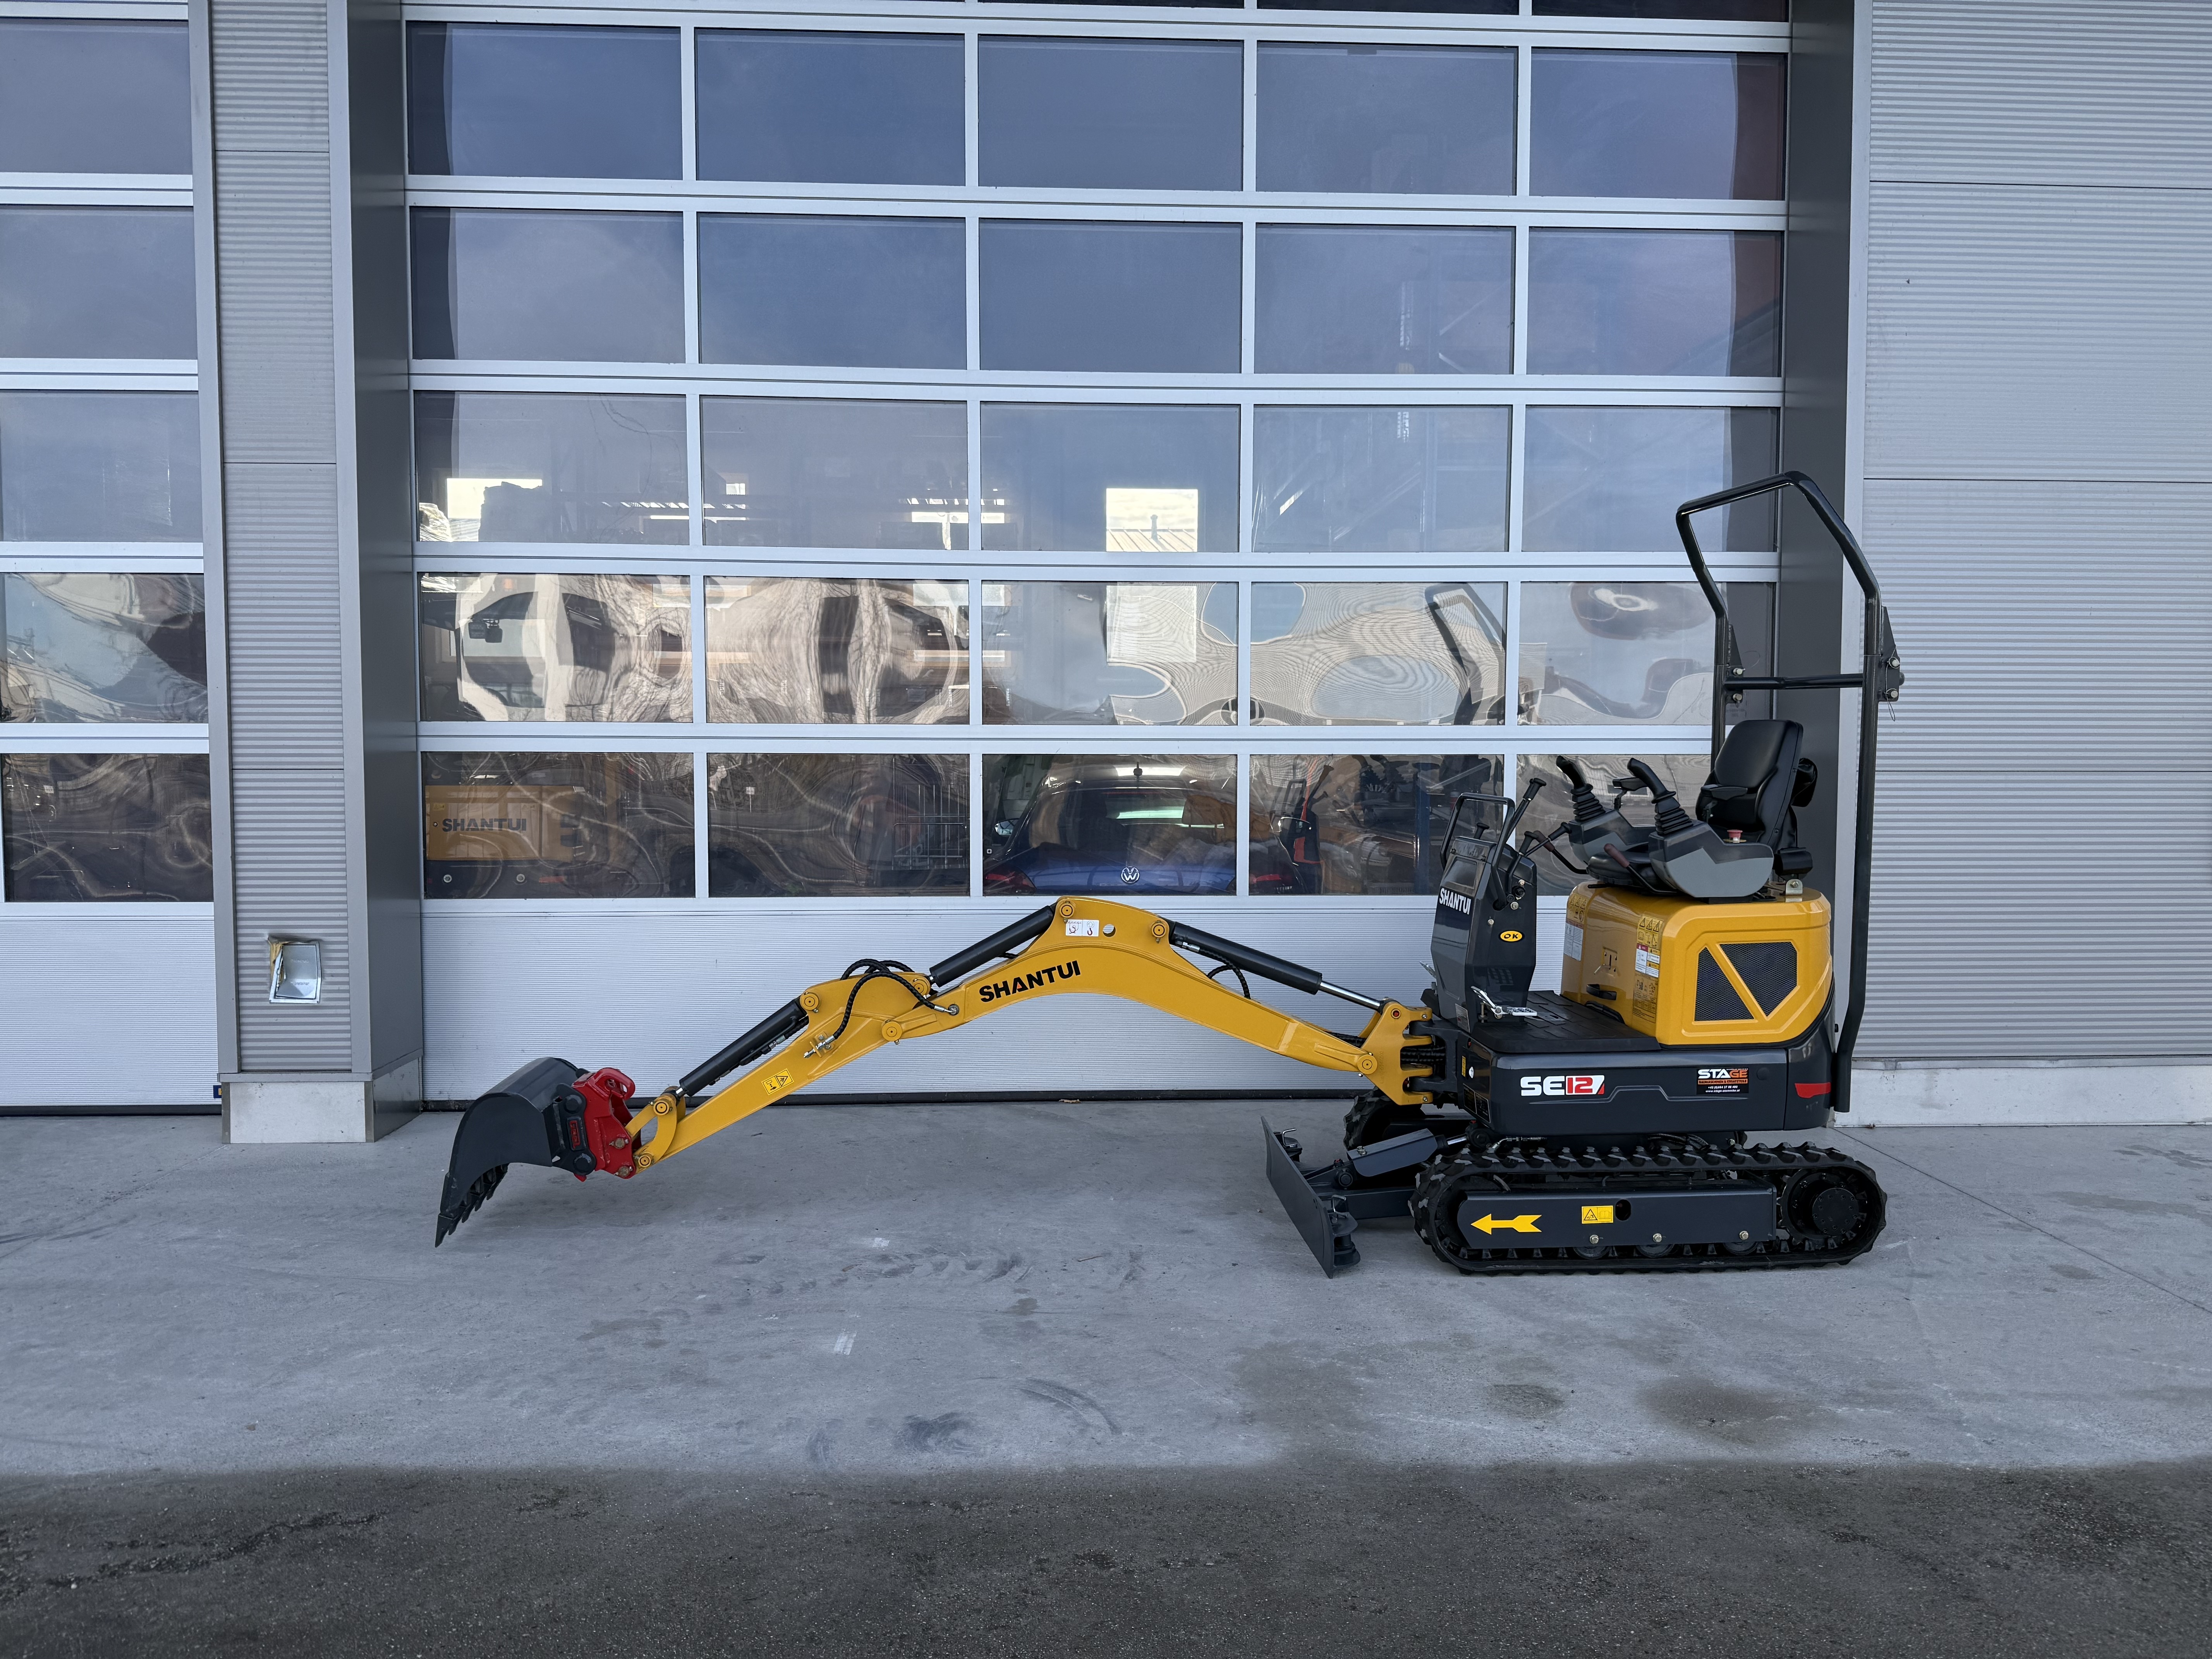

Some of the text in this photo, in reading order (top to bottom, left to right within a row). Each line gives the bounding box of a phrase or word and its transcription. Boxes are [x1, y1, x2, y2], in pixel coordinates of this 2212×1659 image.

[442, 818, 527, 832] SHANTUI
[1439, 888, 1471, 915] SHANTUI
[979, 960, 1081, 1002] SHANTUI
[1698, 1068, 1748, 1079] STAGE
[1520, 1075, 1593, 1096] SE12
